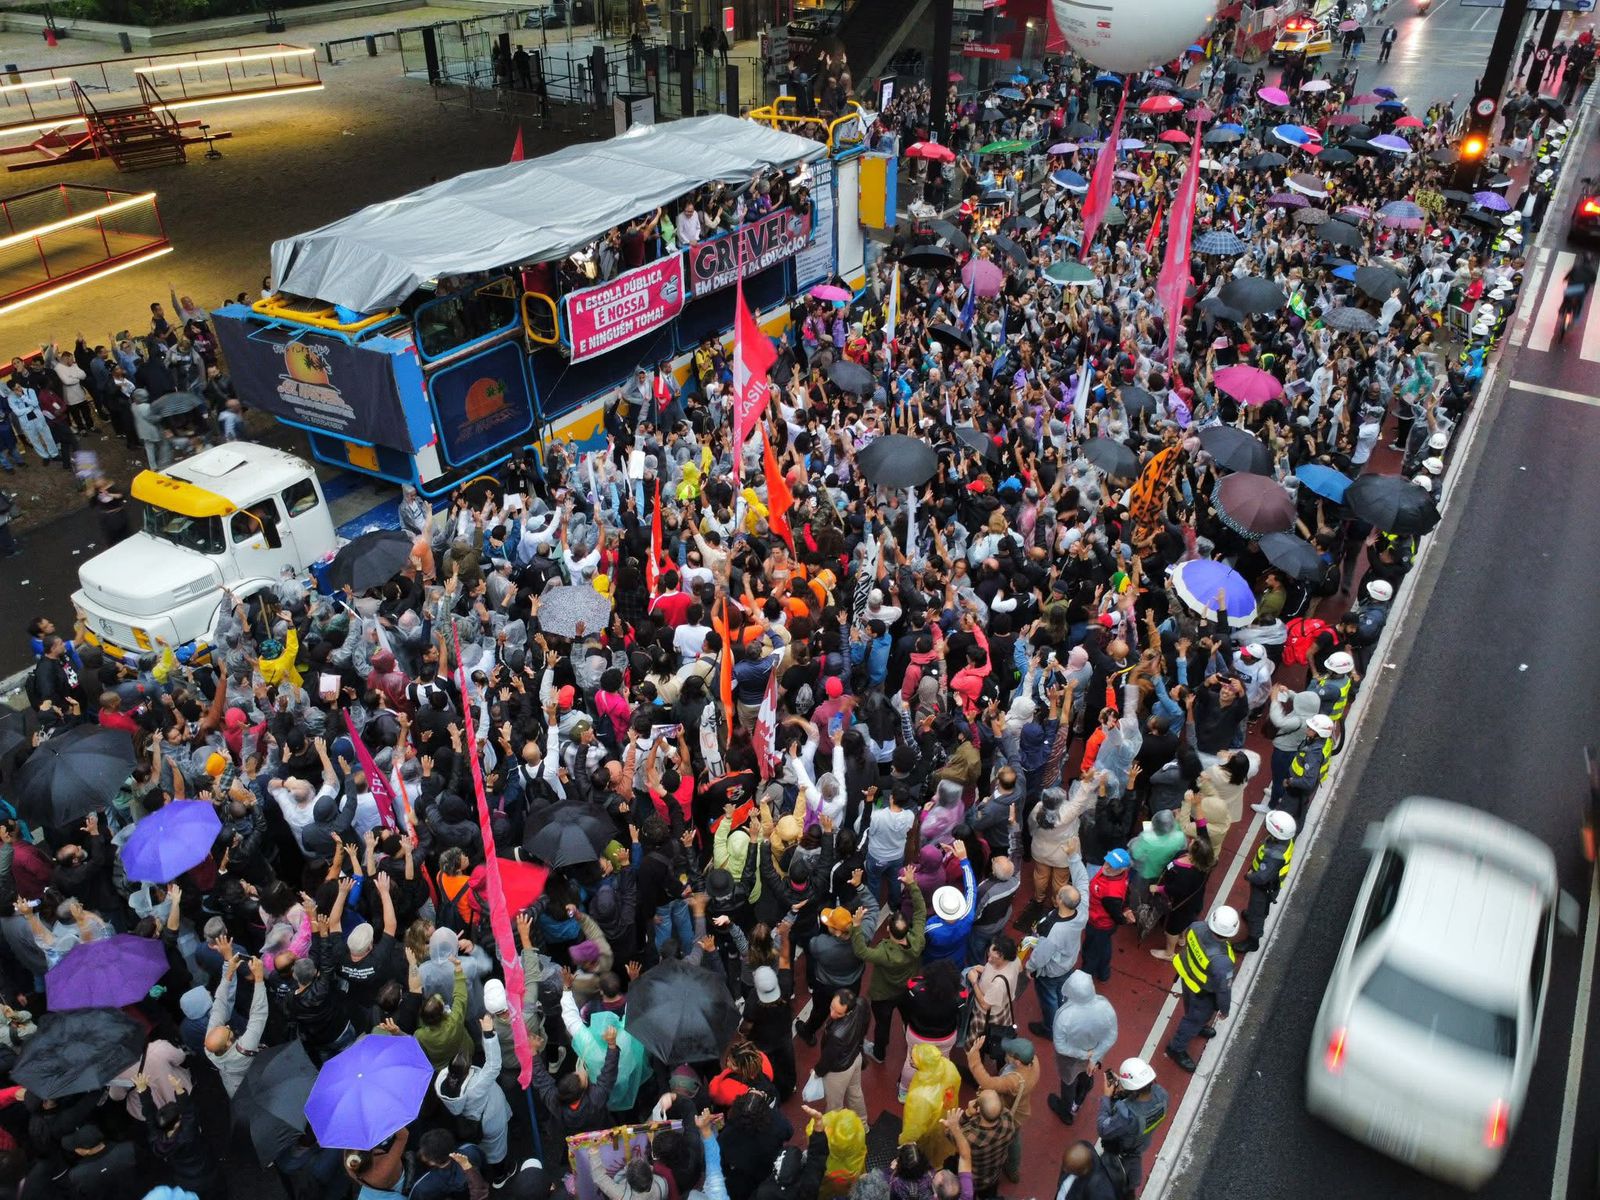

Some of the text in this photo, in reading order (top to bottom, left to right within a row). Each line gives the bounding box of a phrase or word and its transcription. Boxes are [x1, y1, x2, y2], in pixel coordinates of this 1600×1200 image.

[694, 213, 788, 280] GREVE!
[576, 269, 663, 315] A ESCOLA PÚBLICA
[695, 280, 712, 296] EM
[748, 261, 760, 275] DA
[580, 305, 665, 354] E NINGUÉM TOMA!
[597, 294, 646, 327] É NOSSA
